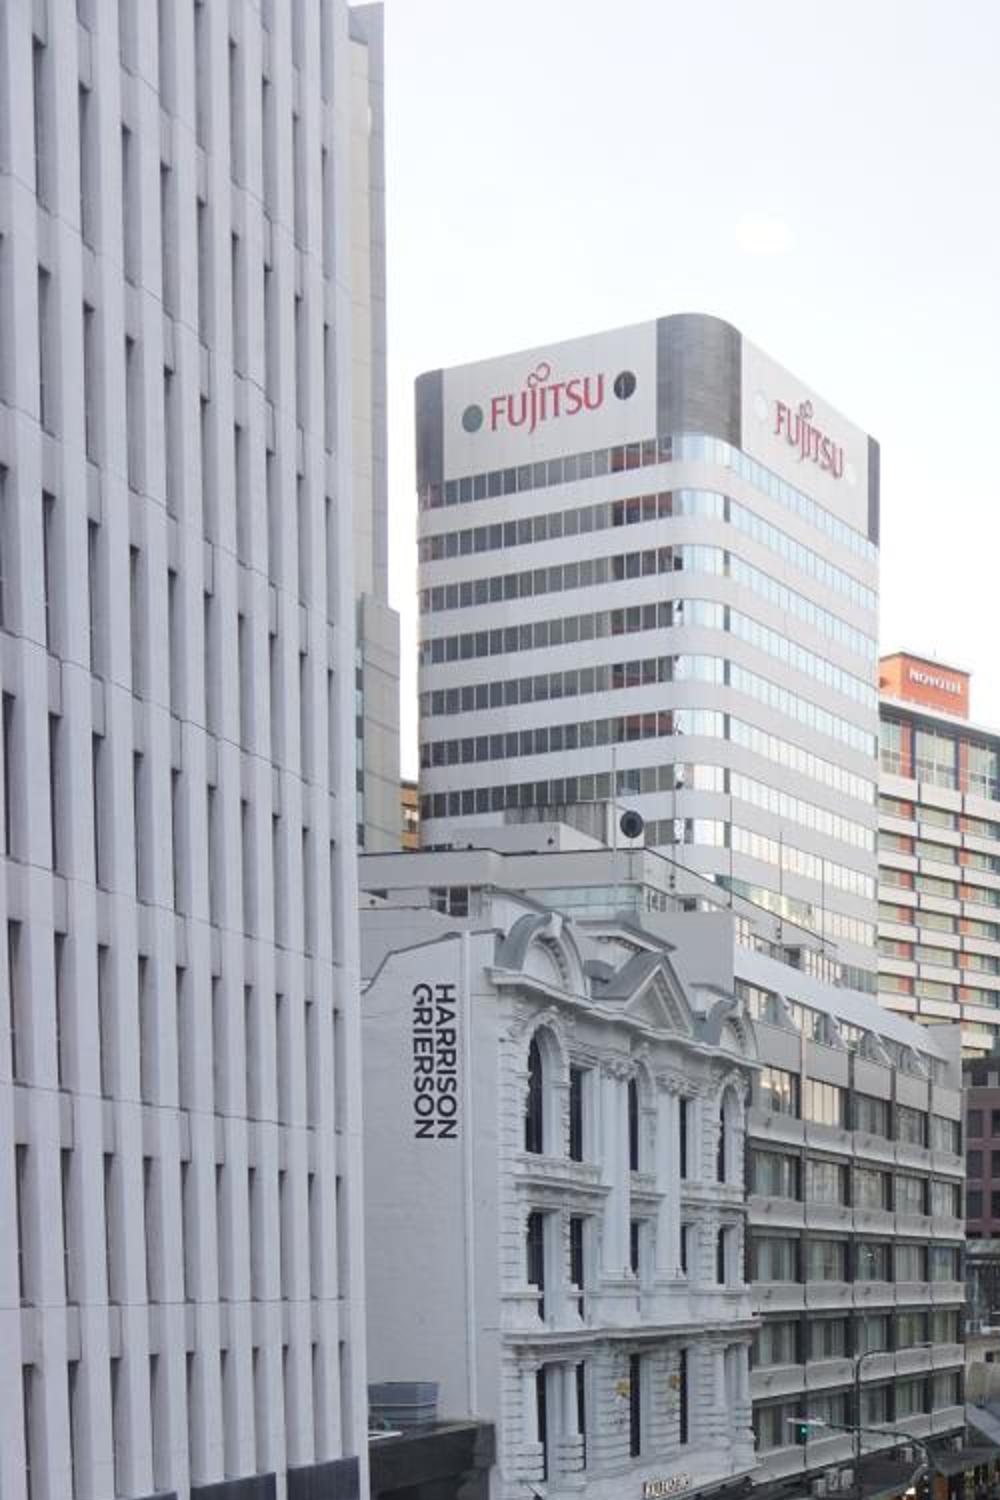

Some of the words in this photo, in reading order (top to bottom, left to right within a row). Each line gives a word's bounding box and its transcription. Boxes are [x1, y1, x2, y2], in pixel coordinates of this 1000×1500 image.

[491, 363, 605, 433] FUJITSU
[774, 400, 844, 479] FUJITSU
[412, 983, 435, 1139] GRIERSON
[435, 983, 458, 1139] HARRISON
